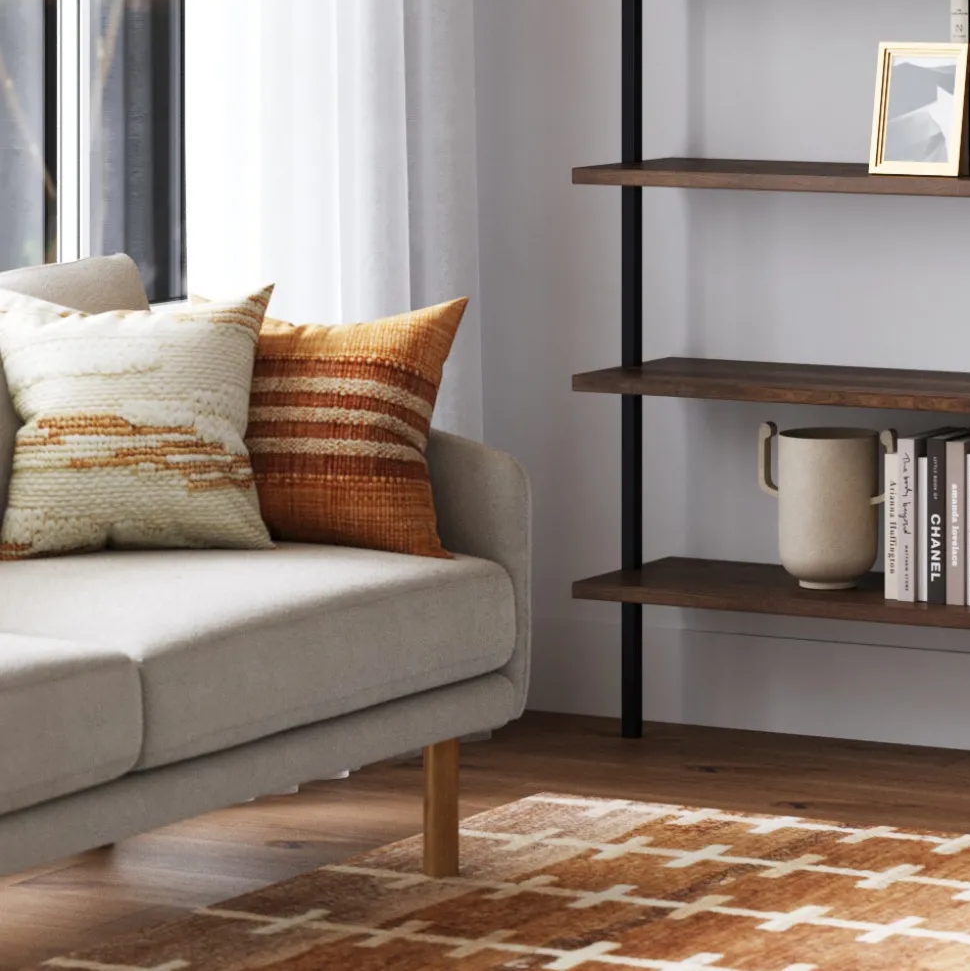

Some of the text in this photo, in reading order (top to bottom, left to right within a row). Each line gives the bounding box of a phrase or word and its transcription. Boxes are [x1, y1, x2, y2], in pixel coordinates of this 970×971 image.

[887, 480, 897, 574] Arianna Huffington
[930, 513, 941, 582] CHANEL
[951, 483, 959, 567] amanda lovelace
